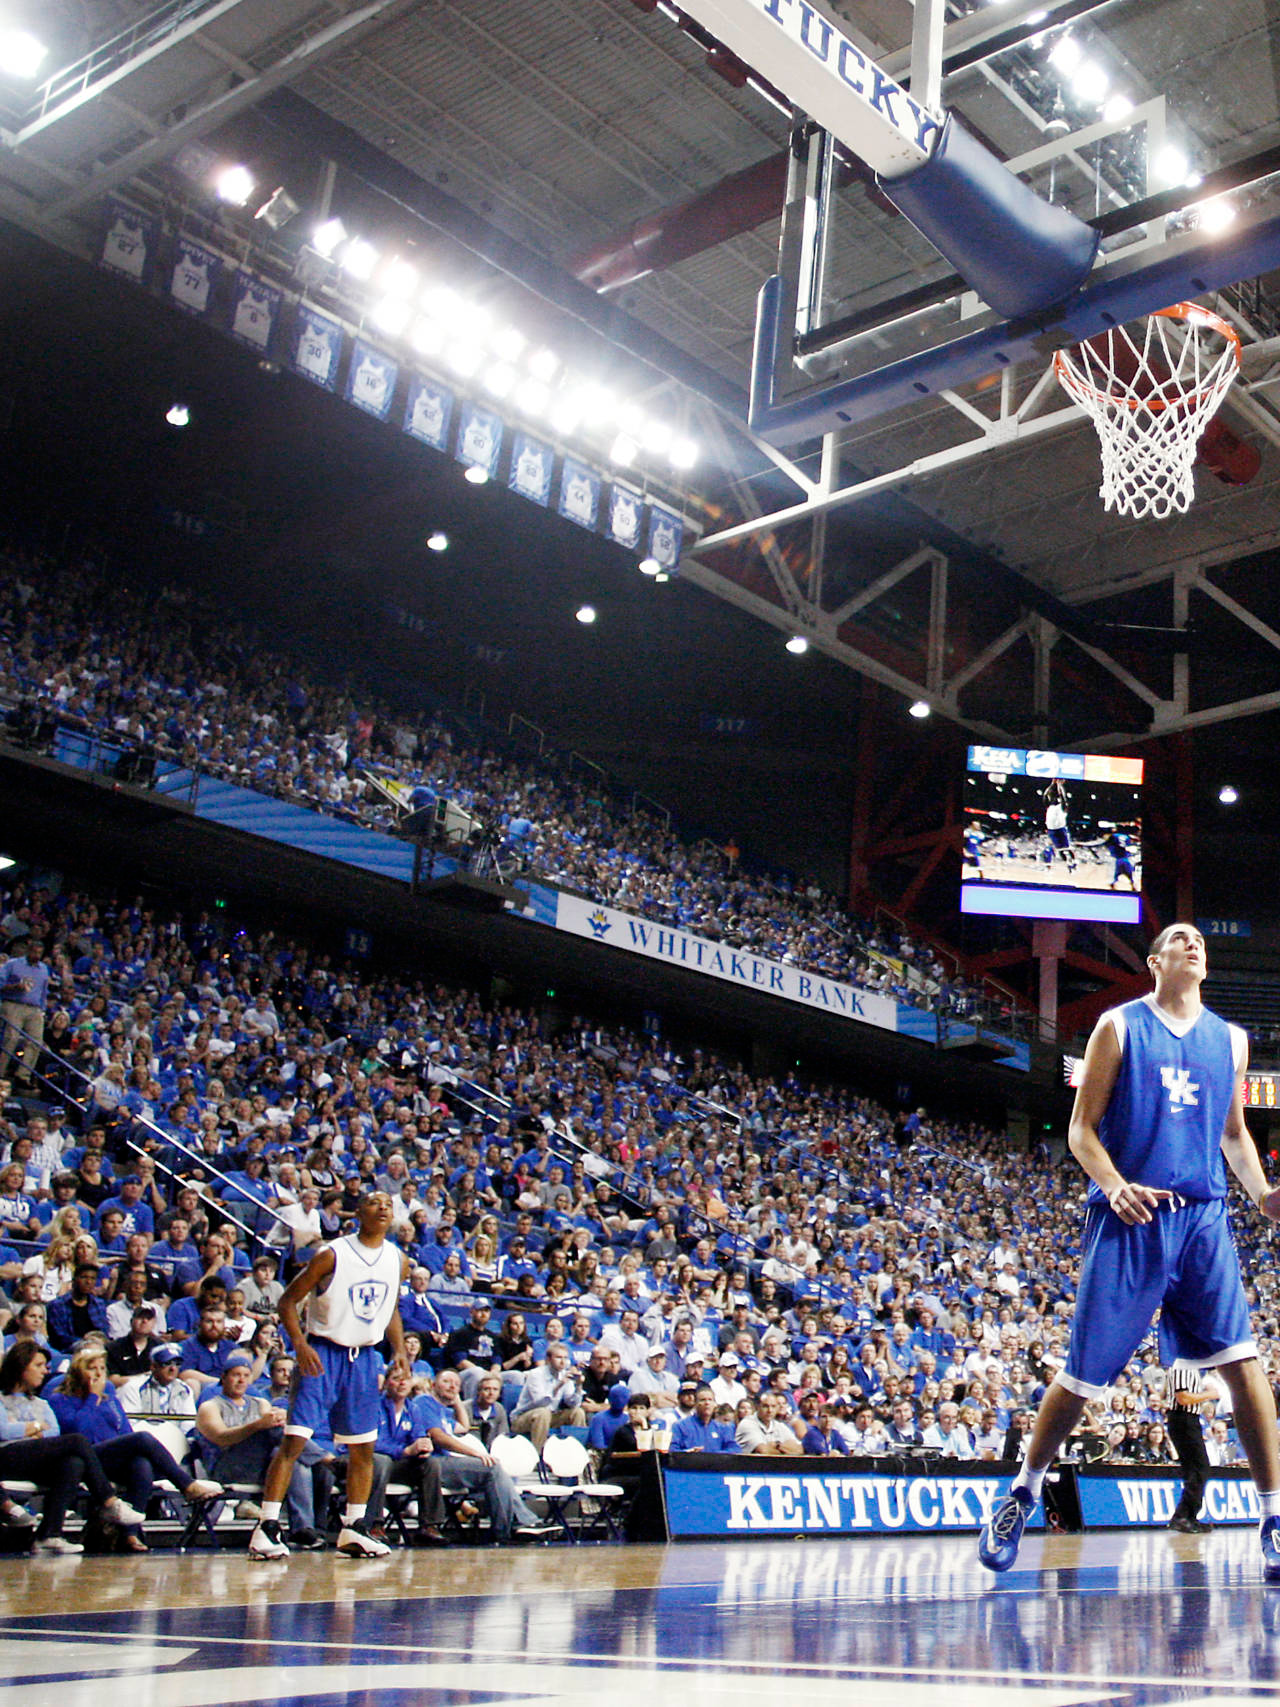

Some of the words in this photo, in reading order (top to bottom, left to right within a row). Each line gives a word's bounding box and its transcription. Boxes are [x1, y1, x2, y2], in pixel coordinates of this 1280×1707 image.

[185, 273, 200, 290] 77
[1211, 921, 1238, 934] 218
[628, 920, 785, 992] WHITAKER
[799, 975, 866, 1017] BANK
[1160, 1067, 1199, 1105] UK
[359, 1287, 379, 1306] UK
[723, 1476, 999, 1528] KENTUCKY
